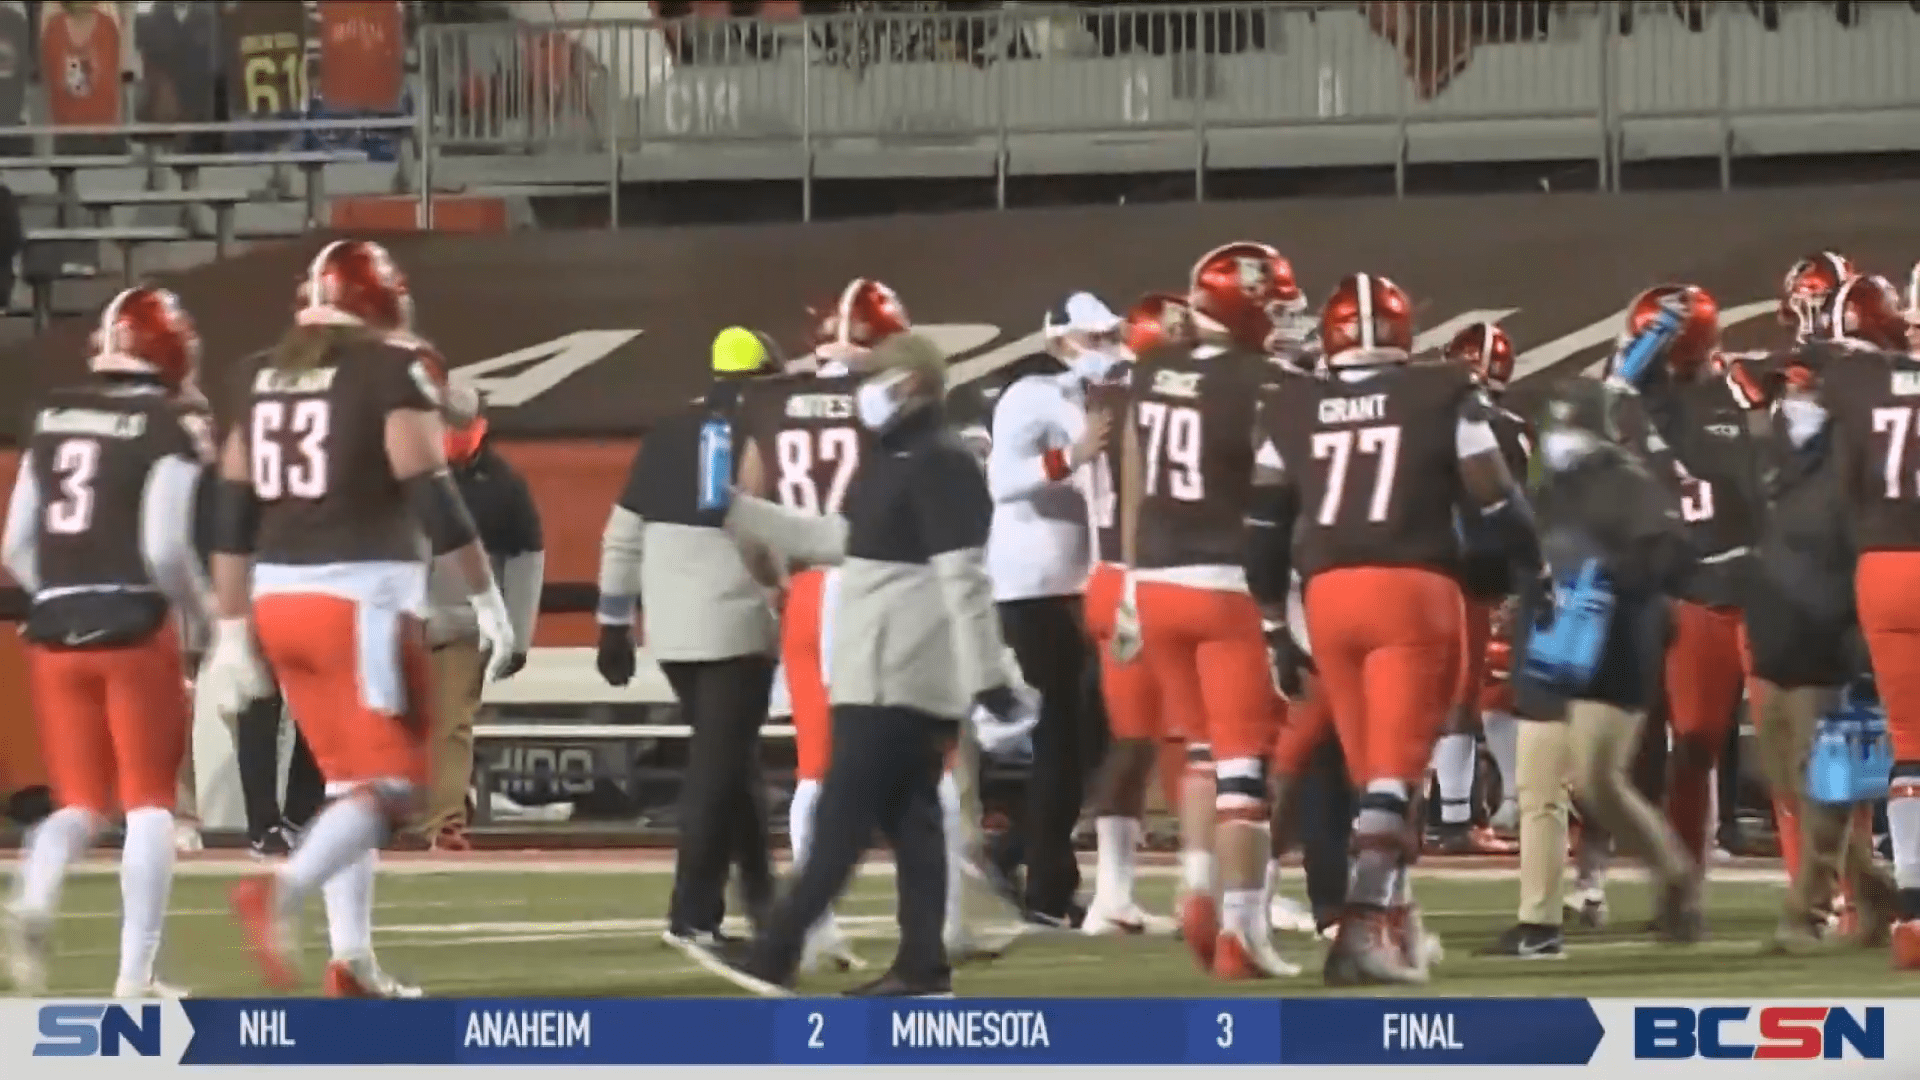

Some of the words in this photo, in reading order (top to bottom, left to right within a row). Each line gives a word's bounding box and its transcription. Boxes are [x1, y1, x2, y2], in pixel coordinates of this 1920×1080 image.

[46, 438, 101, 535] 3
[251, 399, 330, 500] 63
[1138, 401, 1204, 501] 79
[1310, 425, 1402, 526] 77
[1871, 406, 1920, 498] 7
